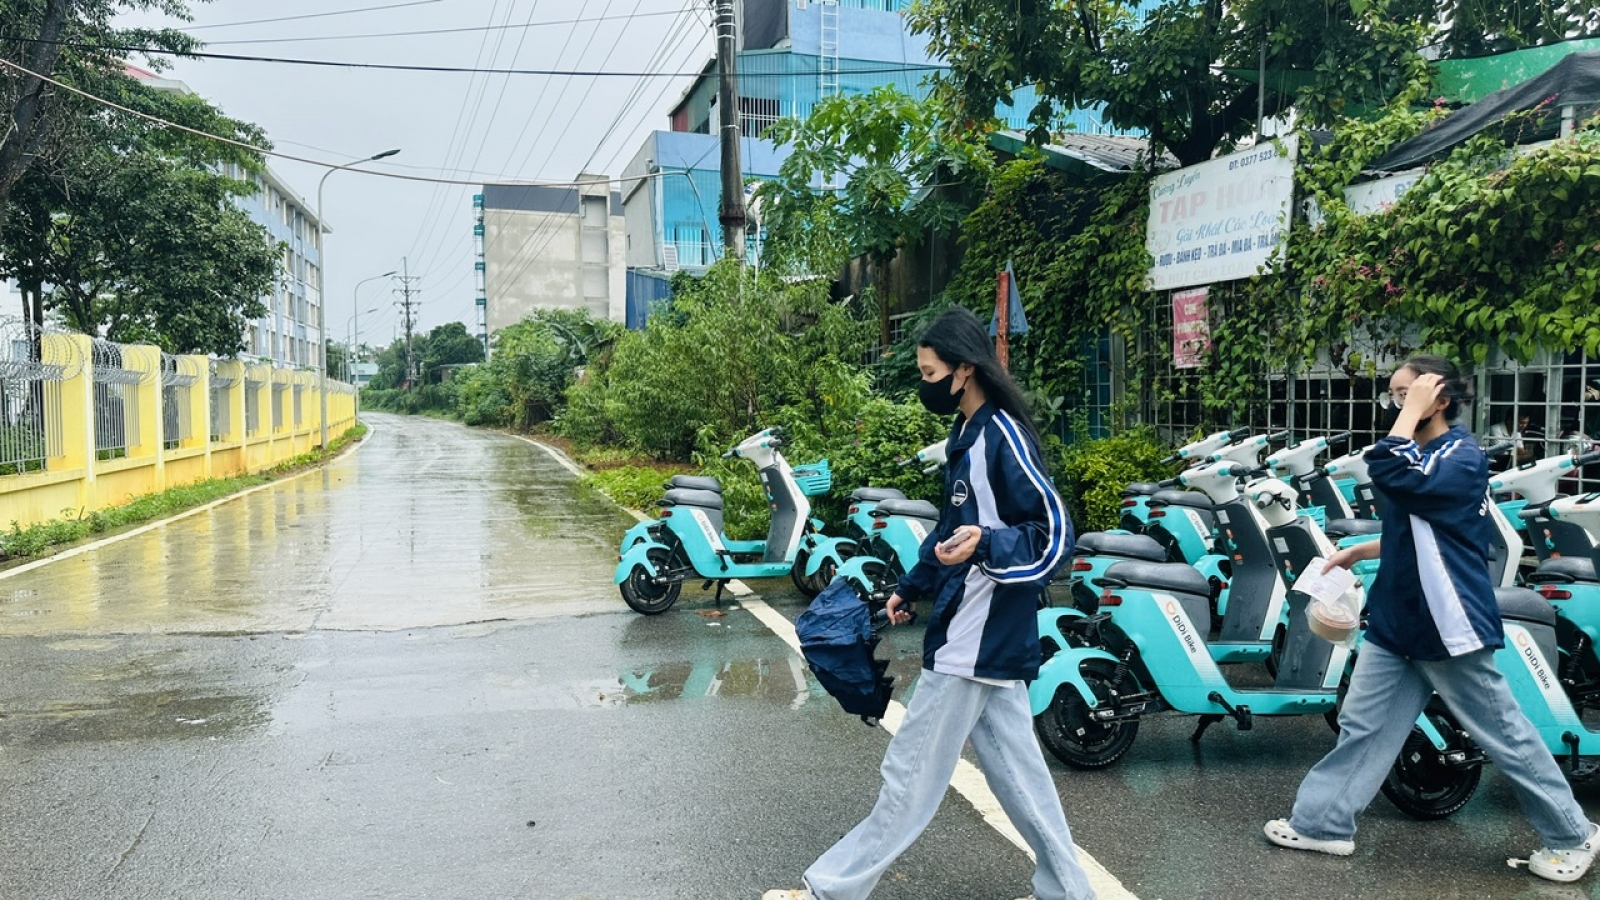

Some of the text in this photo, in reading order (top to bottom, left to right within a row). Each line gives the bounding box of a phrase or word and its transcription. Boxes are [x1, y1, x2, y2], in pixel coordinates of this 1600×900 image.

[1172, 614, 1197, 654] DiDi Bike
[1524, 646, 1551, 690] DiDi Bike
